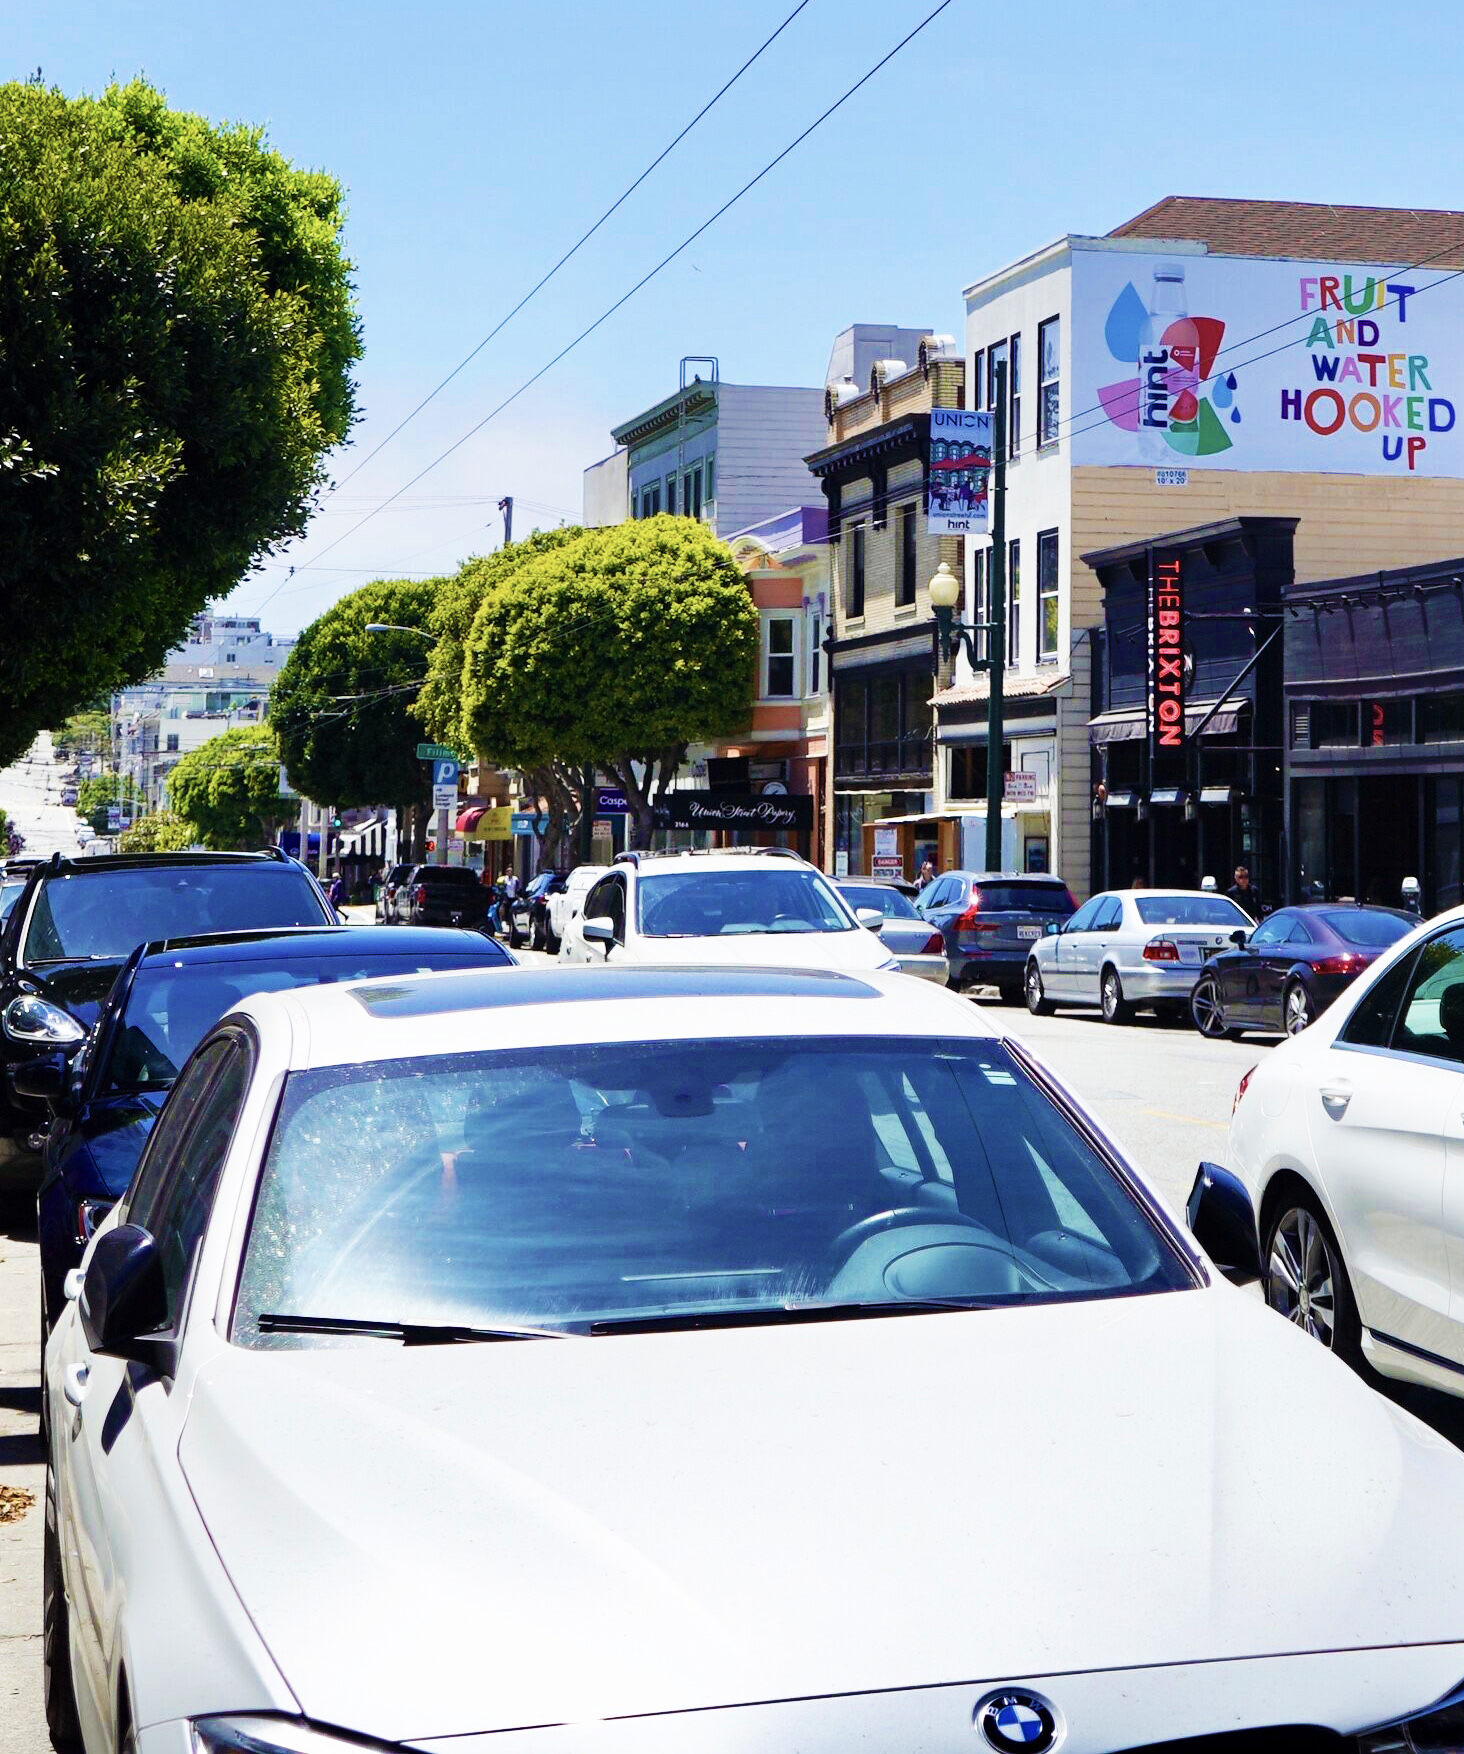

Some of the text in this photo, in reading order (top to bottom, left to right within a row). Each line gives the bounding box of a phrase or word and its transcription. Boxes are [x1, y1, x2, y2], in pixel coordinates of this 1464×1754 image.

[1300, 274, 1415, 322] FRUIT
[1306, 316, 1380, 349] AND
[1143, 348, 1169, 428] hint
[1312, 352, 1433, 392] WATER
[934, 413, 989, 428] UNION
[1281, 387, 1456, 436] HOOKED
[1382, 435, 1427, 470] UP
[947, 519, 970, 530] hint
[689, 801, 723, 819] Union
[985, 1695, 1045, 1717] BMW
